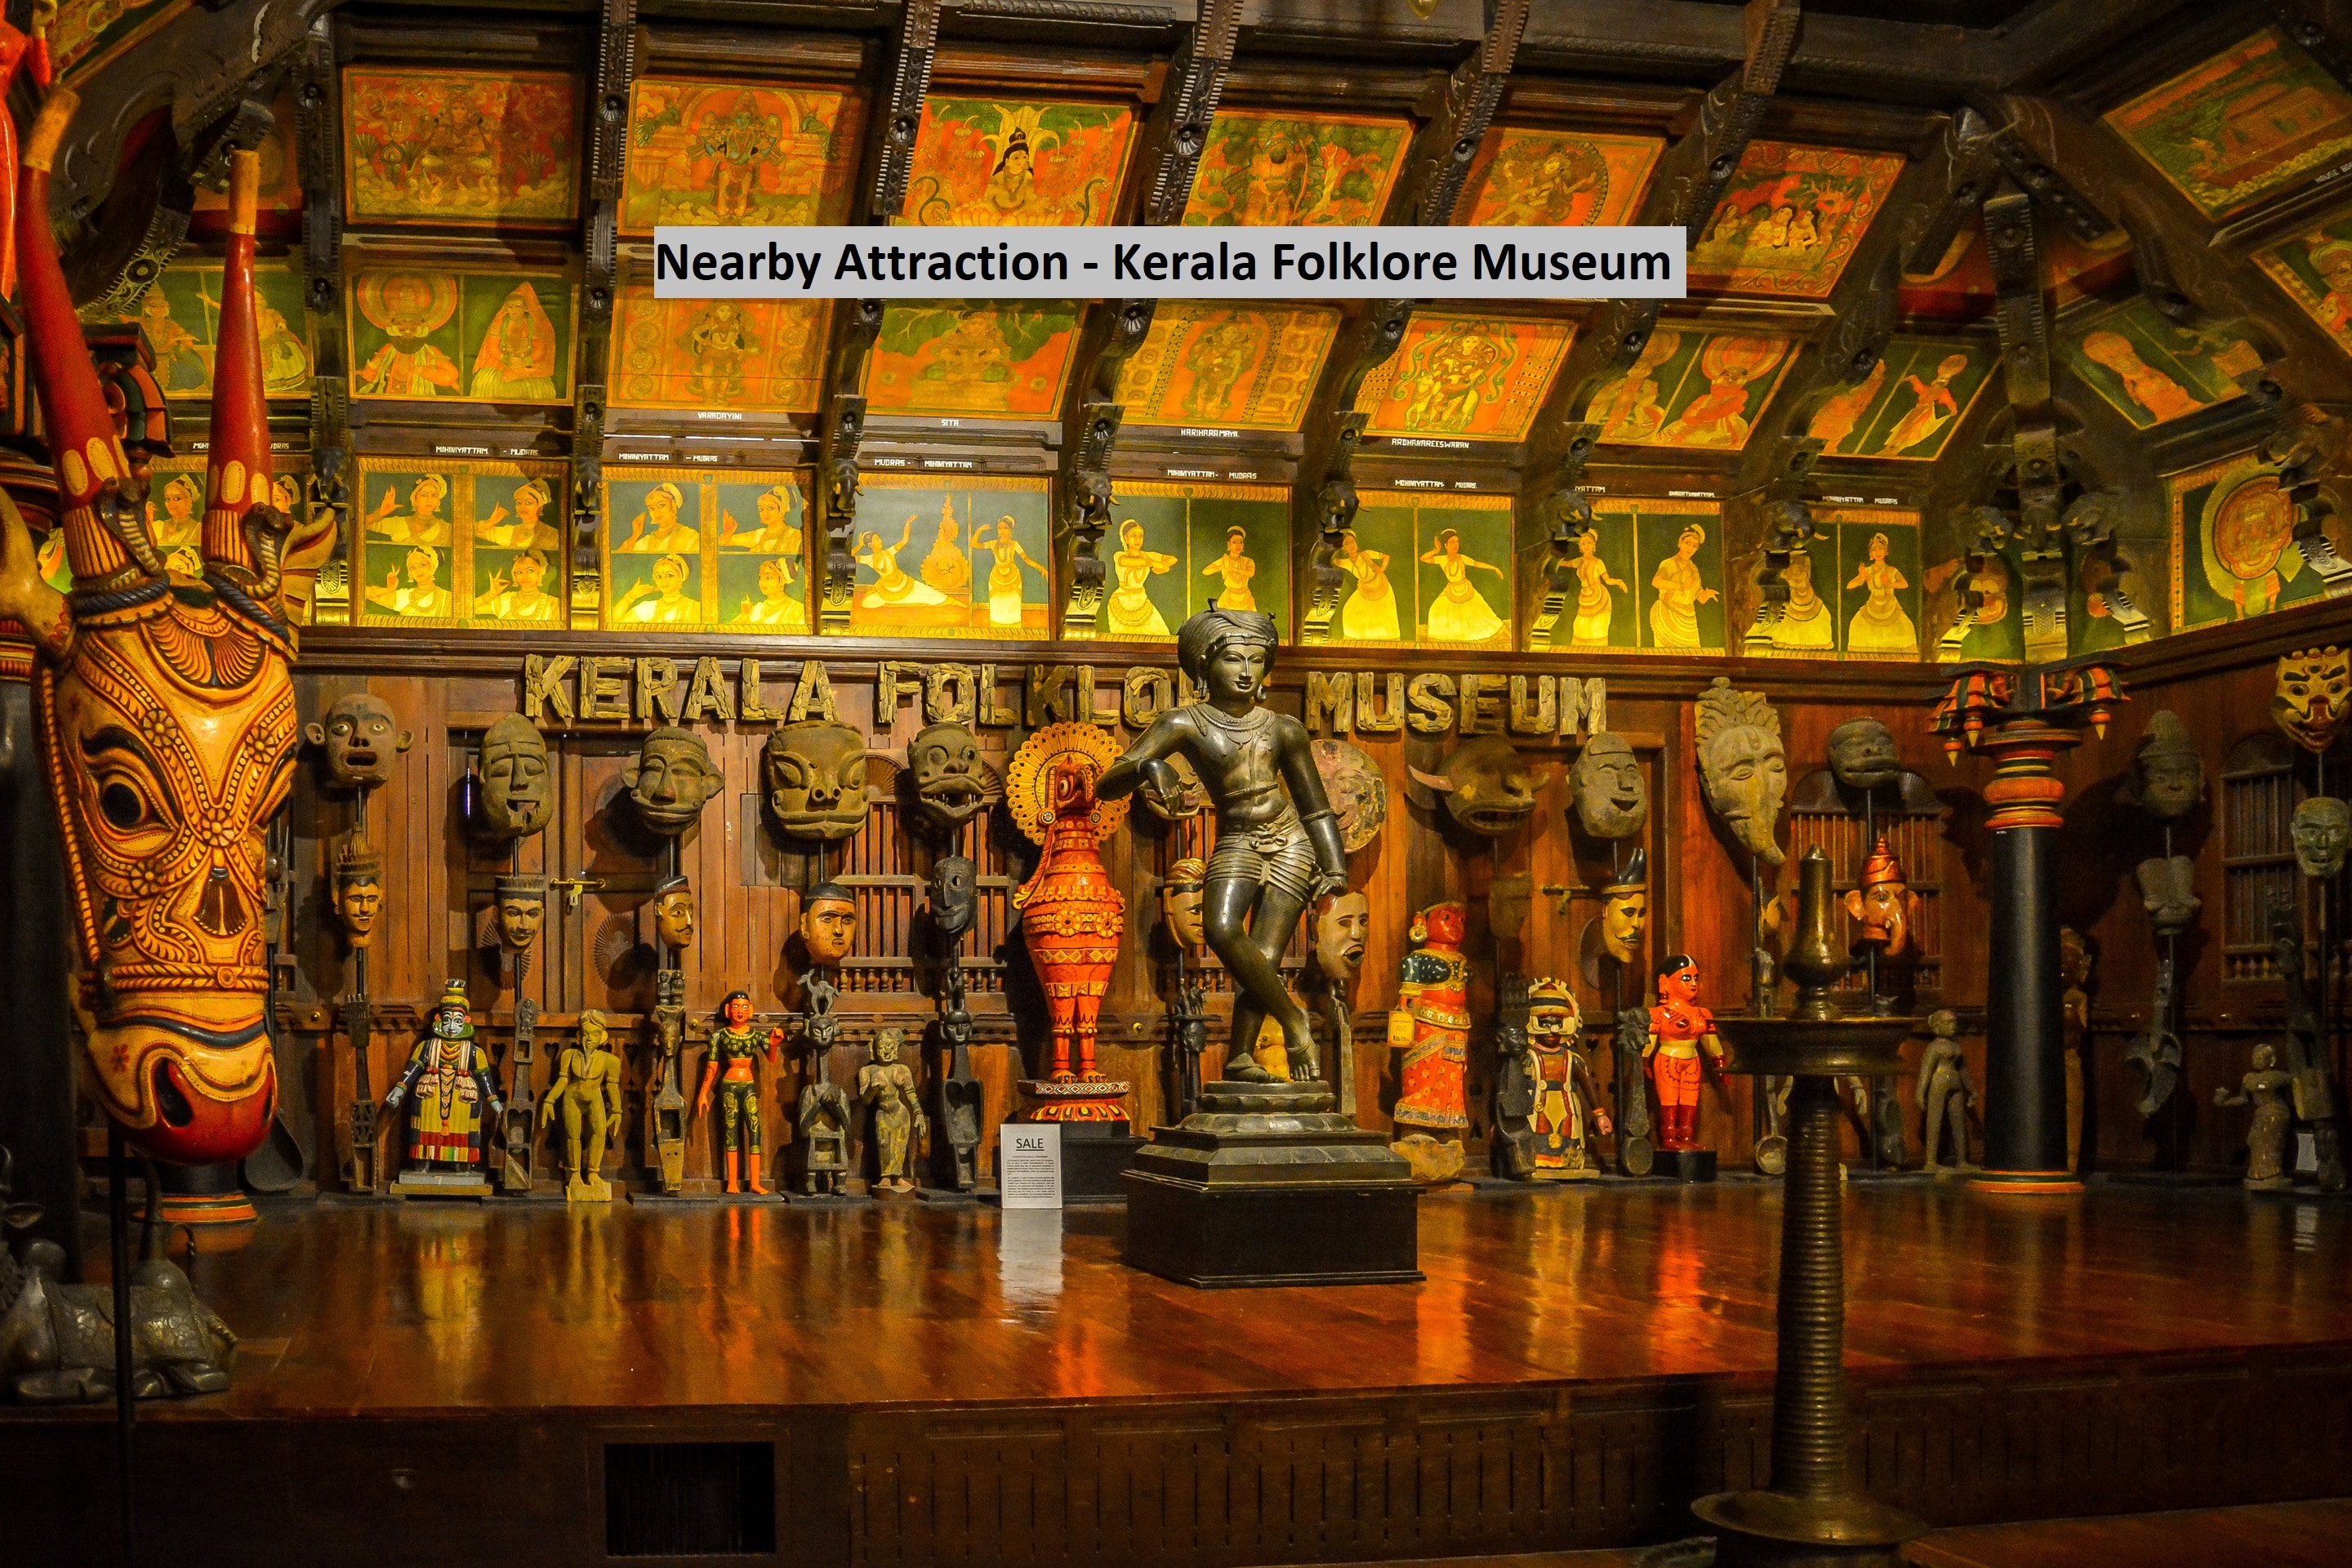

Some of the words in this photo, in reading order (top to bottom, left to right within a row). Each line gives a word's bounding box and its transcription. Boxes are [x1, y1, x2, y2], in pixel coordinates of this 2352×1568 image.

[697, 412, 742, 421] VARADAYINI
[1391, 438, 1470, 449] ARDHANAREESWARAN
[618, 452, 670, 461] MOHINIYATTAM
[924, 460, 973, 469] MOHINIYATTAM
[525, 654, 840, 722] KERALA
[878, 661, 1271, 728] FOLKLO
[1307, 671, 1607, 735] MUSEUM
[1016, 1138, 1044, 1149] SALE
